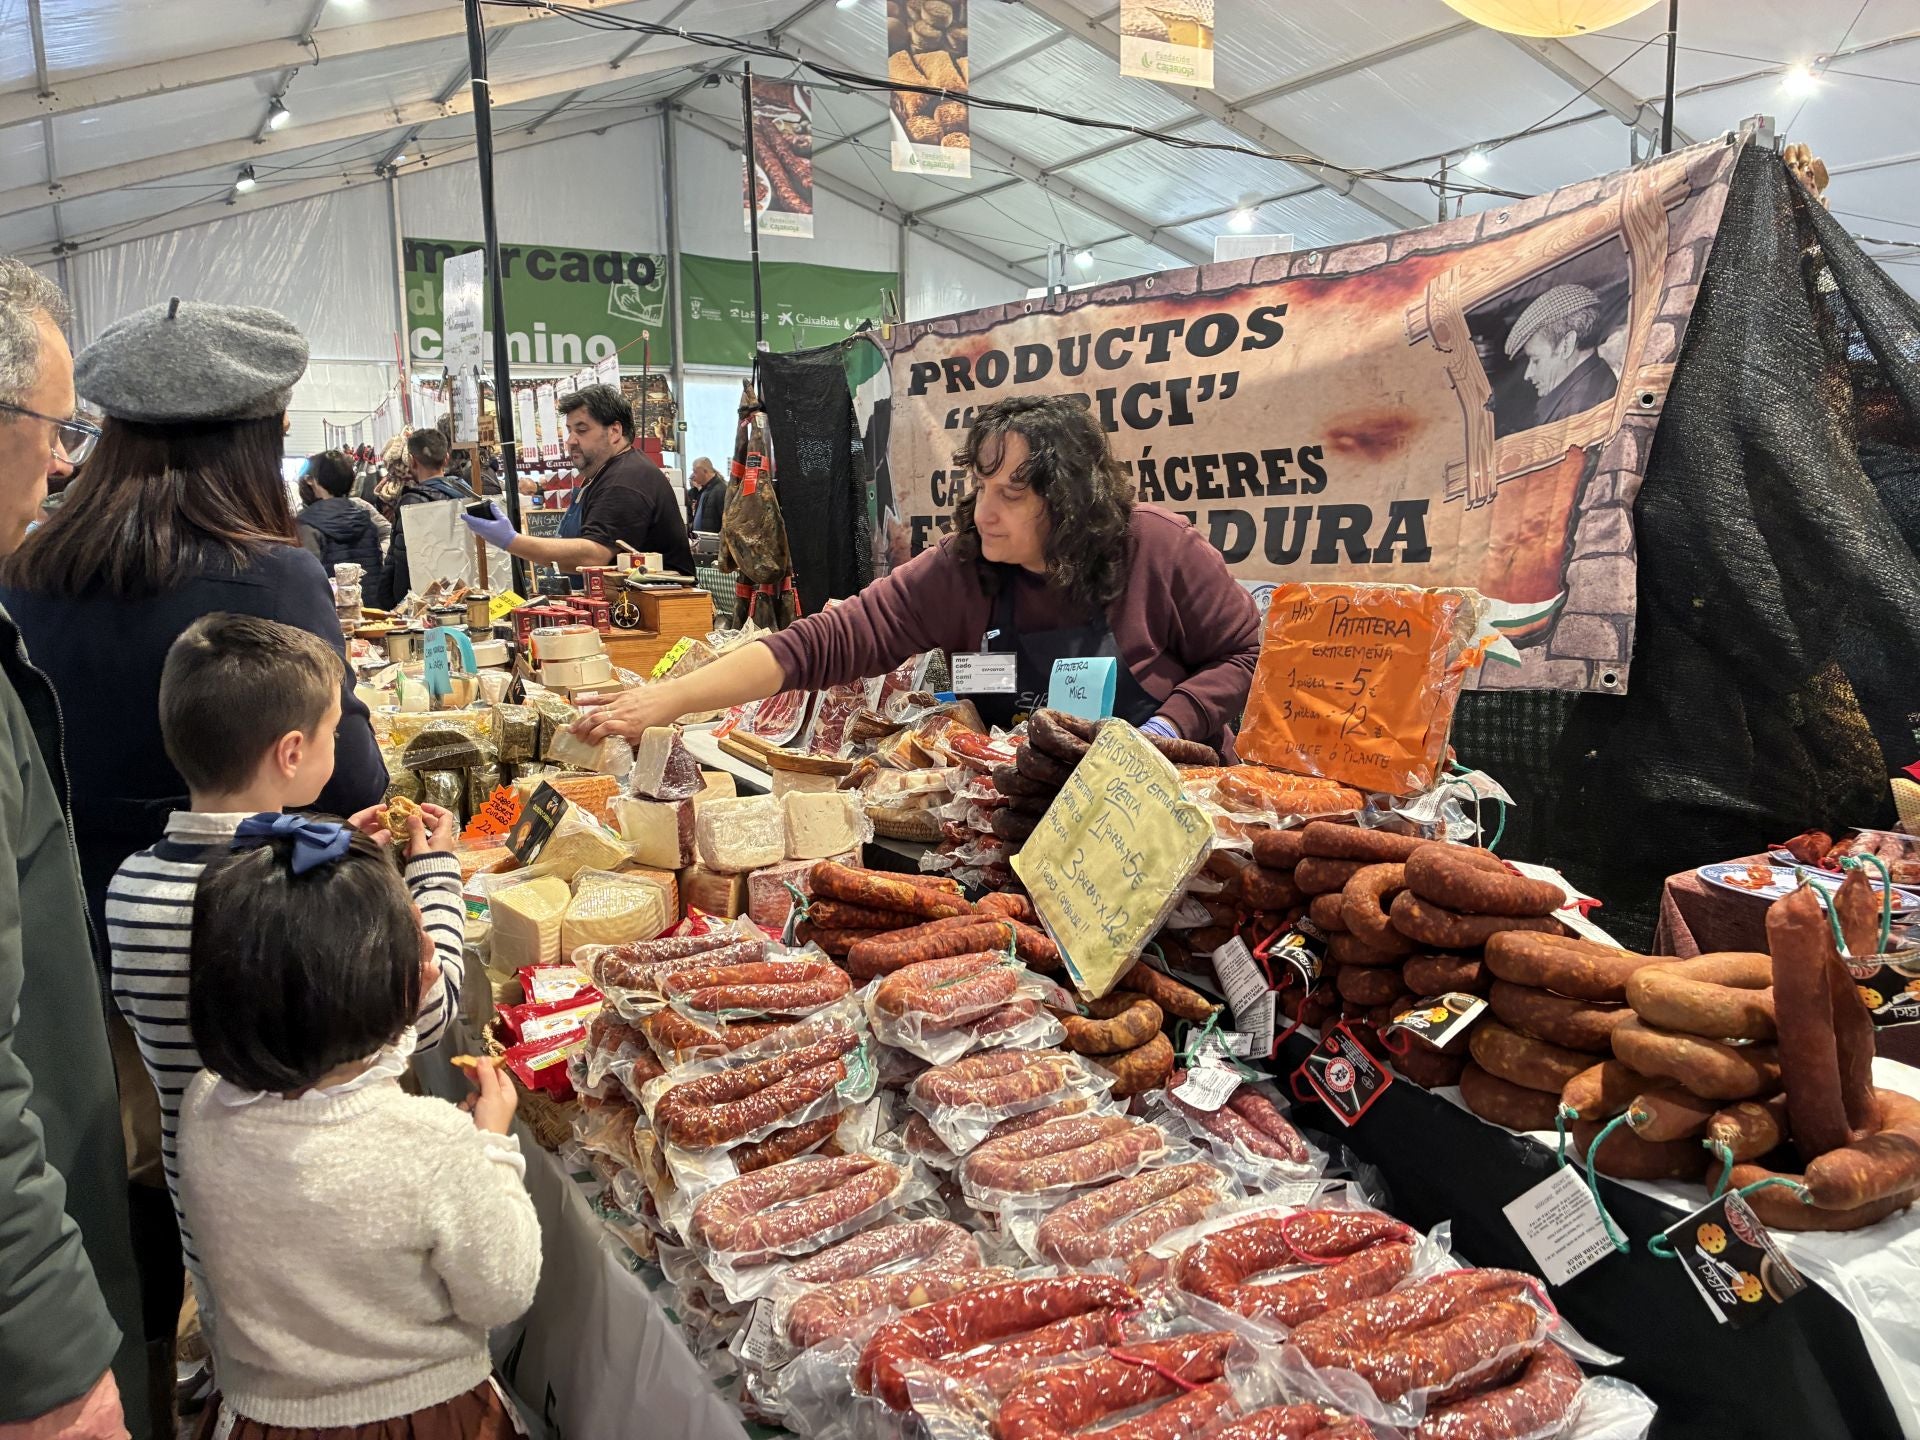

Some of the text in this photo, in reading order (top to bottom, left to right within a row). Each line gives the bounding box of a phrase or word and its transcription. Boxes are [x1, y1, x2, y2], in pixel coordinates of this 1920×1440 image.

[796, 313, 841, 327] CaixaBank
[410, 322, 617, 364] cmino
[907, 303, 1289, 397] PRODUCTOS
[1291, 595, 1412, 638] HAY PATATERA
[1312, 642, 1393, 661] EXTREMEÑA
[1054, 660, 1089, 674] PATATERA
[1065, 675, 1078, 686] CON
[1069, 686, 1088, 699] MIEL
[1284, 740, 1323, 755] DULCE
[1106, 777, 1143, 818] OFERTA
